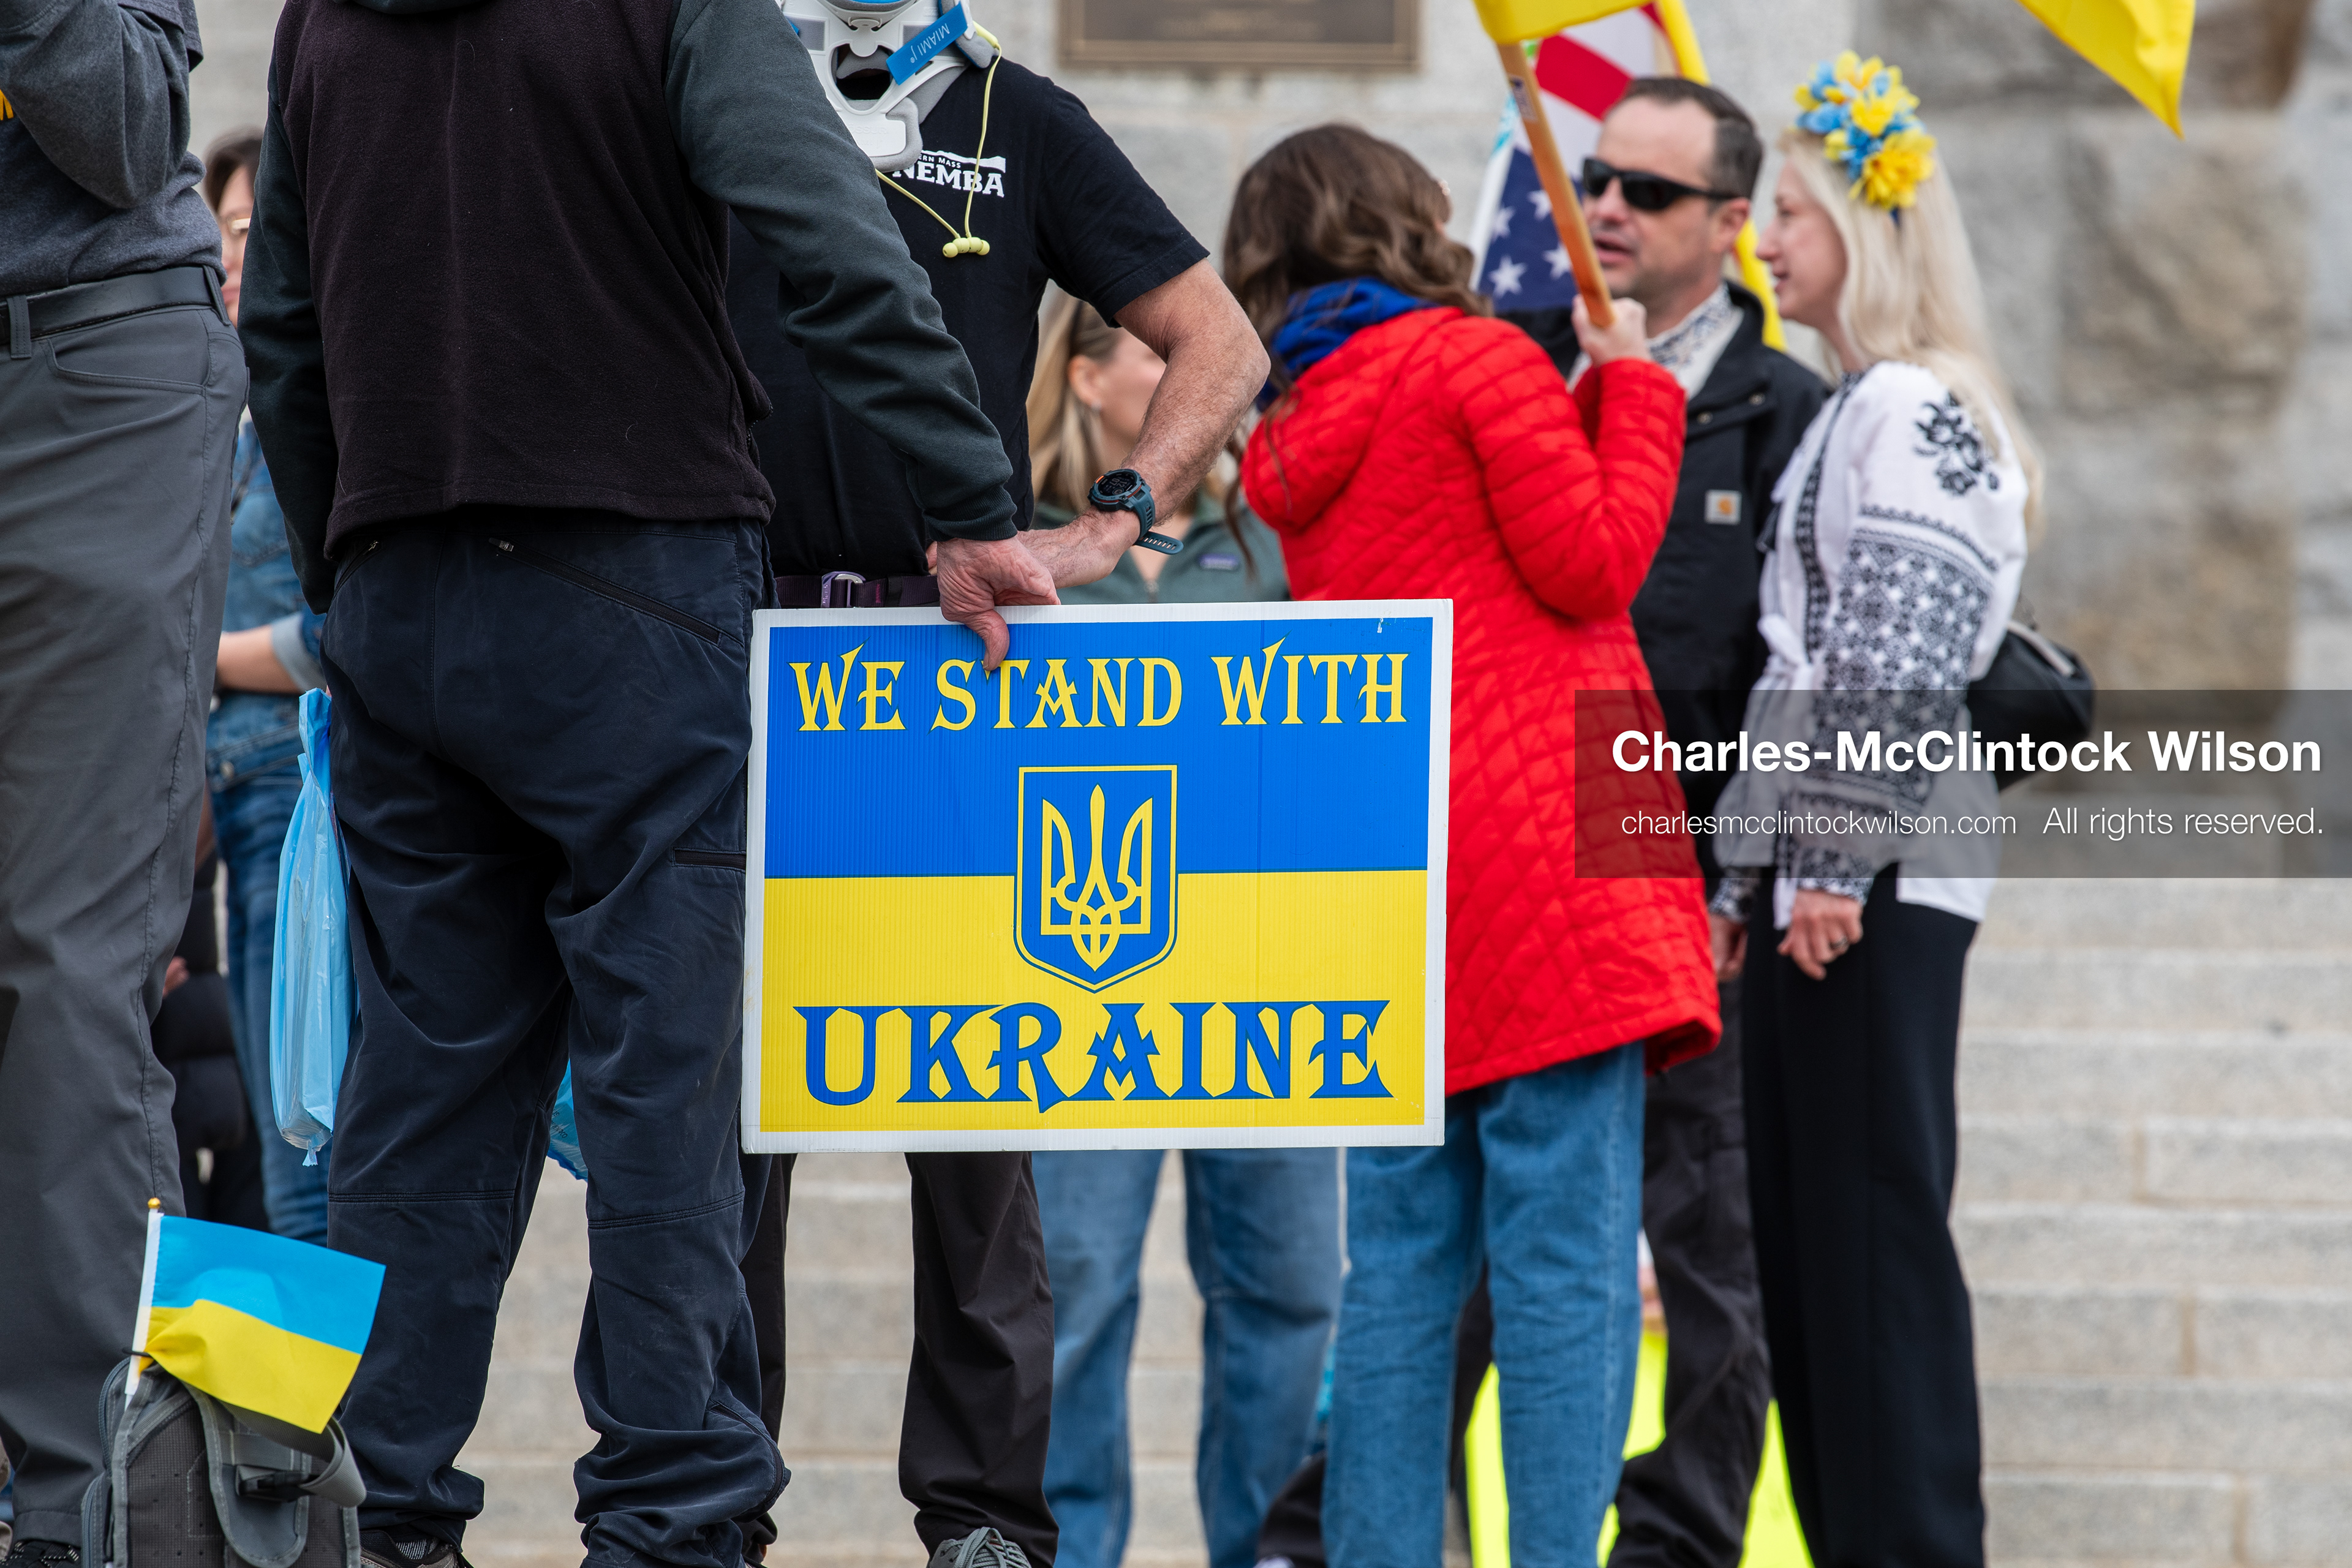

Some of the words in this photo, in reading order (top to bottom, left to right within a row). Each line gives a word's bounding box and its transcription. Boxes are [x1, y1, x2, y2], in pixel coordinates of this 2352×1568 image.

[917, 23, 950, 56] MIAMI
[938, 157, 961, 168] MASS
[789, 642, 905, 732] WE
[930, 657, 1183, 733] STAND
[1212, 636, 1408, 726] WITH
[794, 1000, 1393, 1114] UKRAINE
